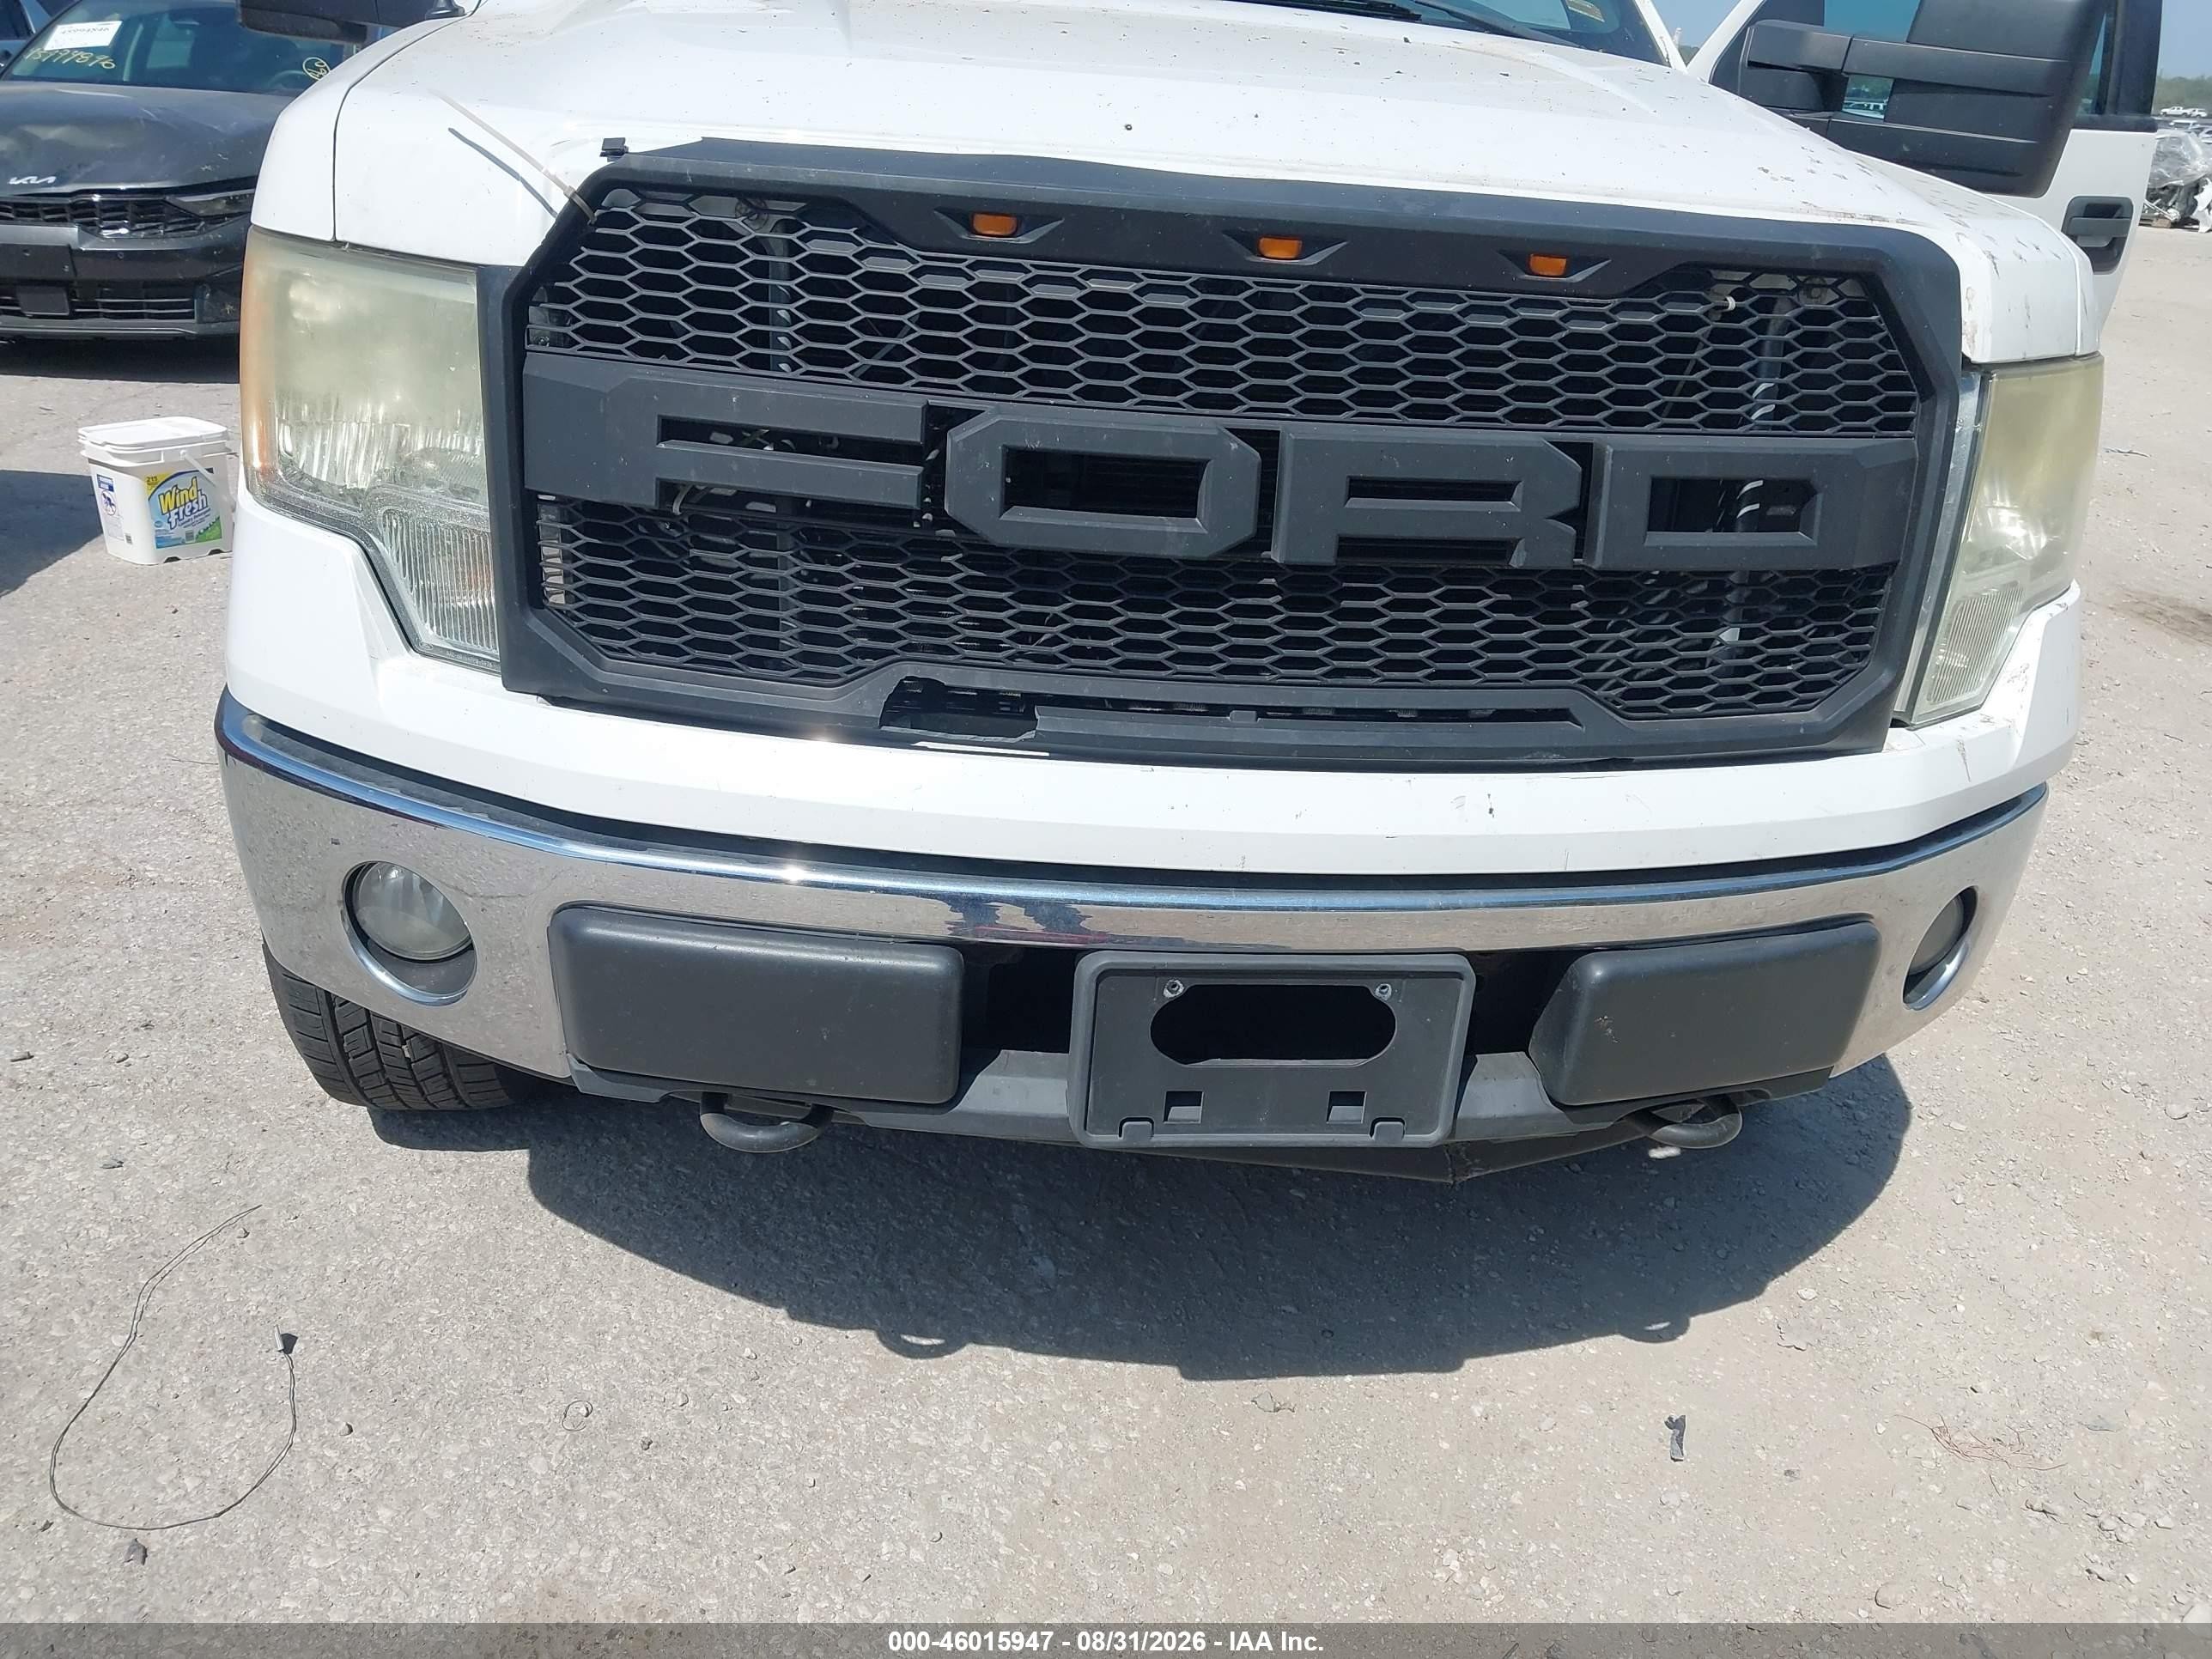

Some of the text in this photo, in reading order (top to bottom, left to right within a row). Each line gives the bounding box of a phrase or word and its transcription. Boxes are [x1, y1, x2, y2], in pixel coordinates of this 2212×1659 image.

[524, 351, 1918, 571] FORD
[158, 476, 198, 515] Wind
[167, 489, 209, 530] Fresh
